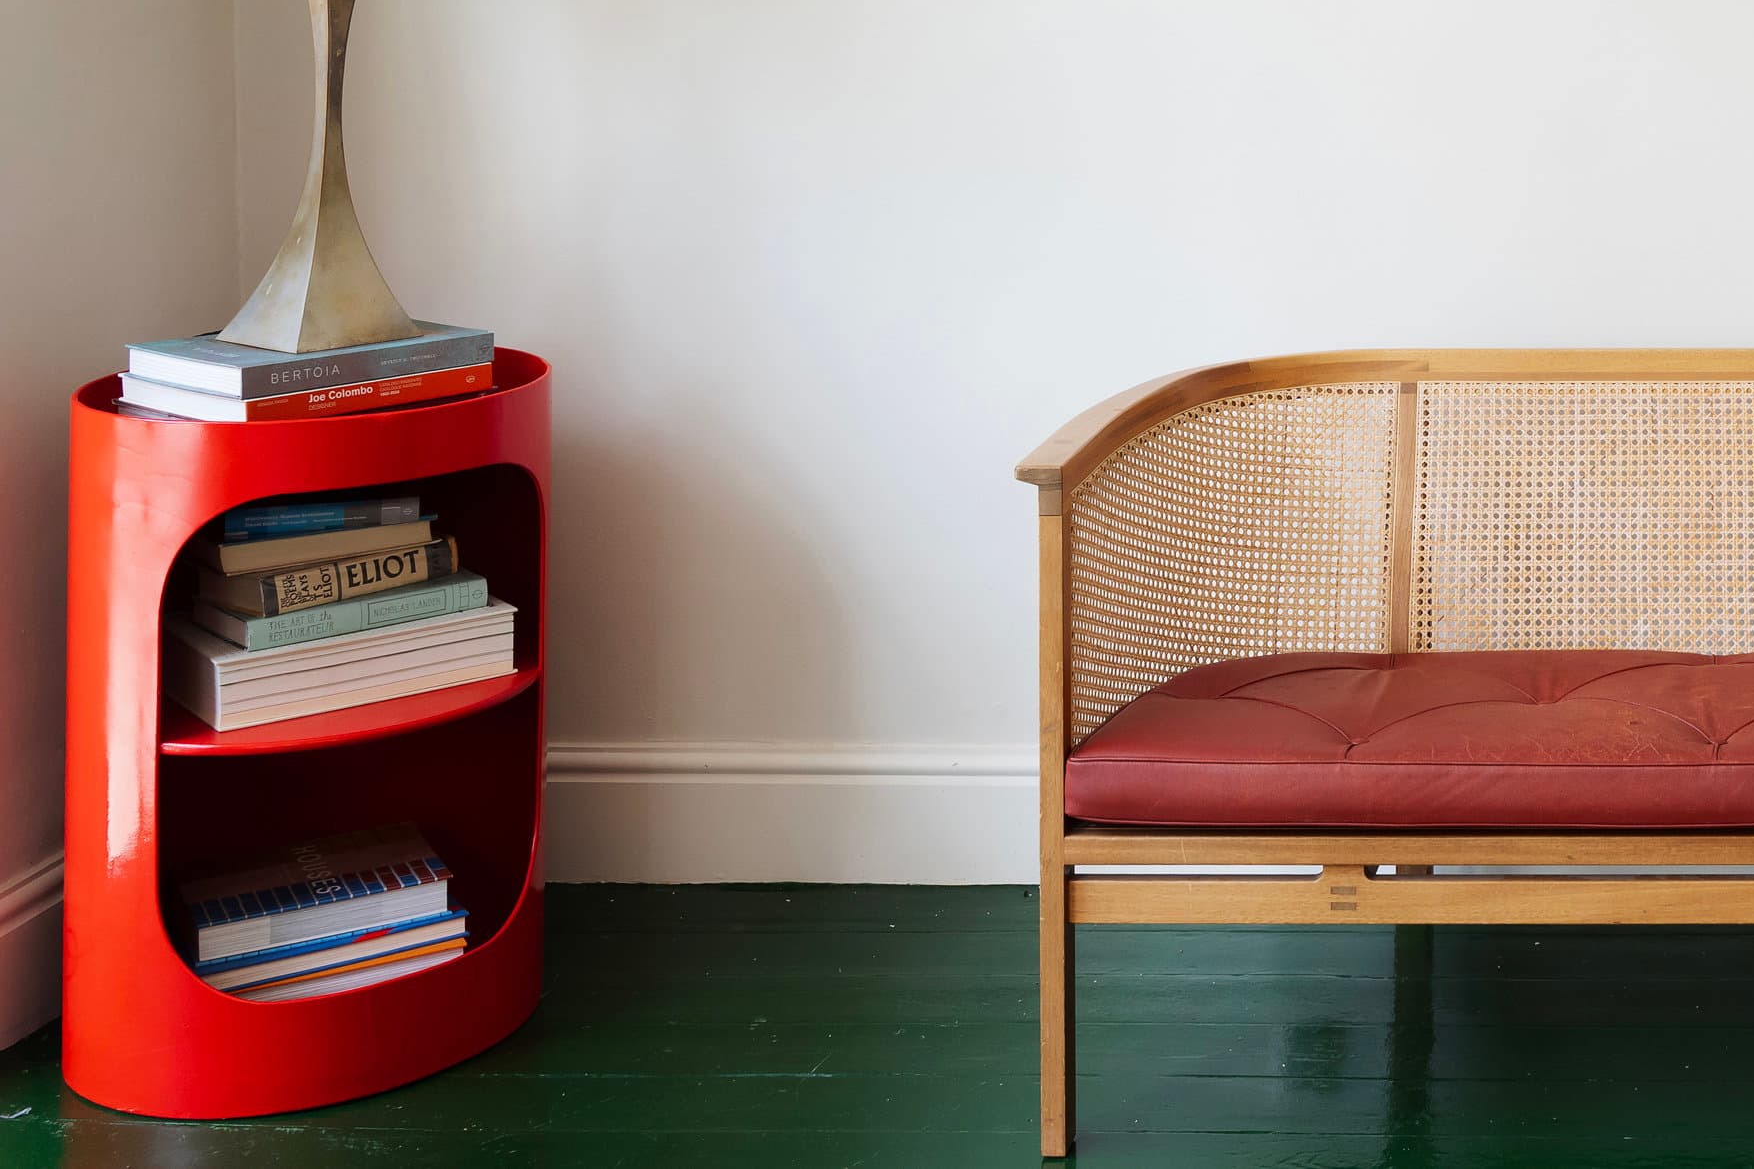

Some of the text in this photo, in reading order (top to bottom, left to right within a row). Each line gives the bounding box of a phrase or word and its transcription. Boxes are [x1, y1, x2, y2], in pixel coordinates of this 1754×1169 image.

[271, 364, 340, 384] BERTOIA
[308, 393, 326, 404] Joe
[328, 385, 374, 400] Colombo
[320, 565, 333, 599] ELIOT
[345, 549, 420, 588] ELIOT
[286, 574, 298, 605] POEMS
[299, 574, 311, 603] PLAYS
[313, 584, 323, 592] S
[266, 620, 289, 631] THE
[291, 615, 305, 627] ART
[291, 845, 341, 894] HOUSES
